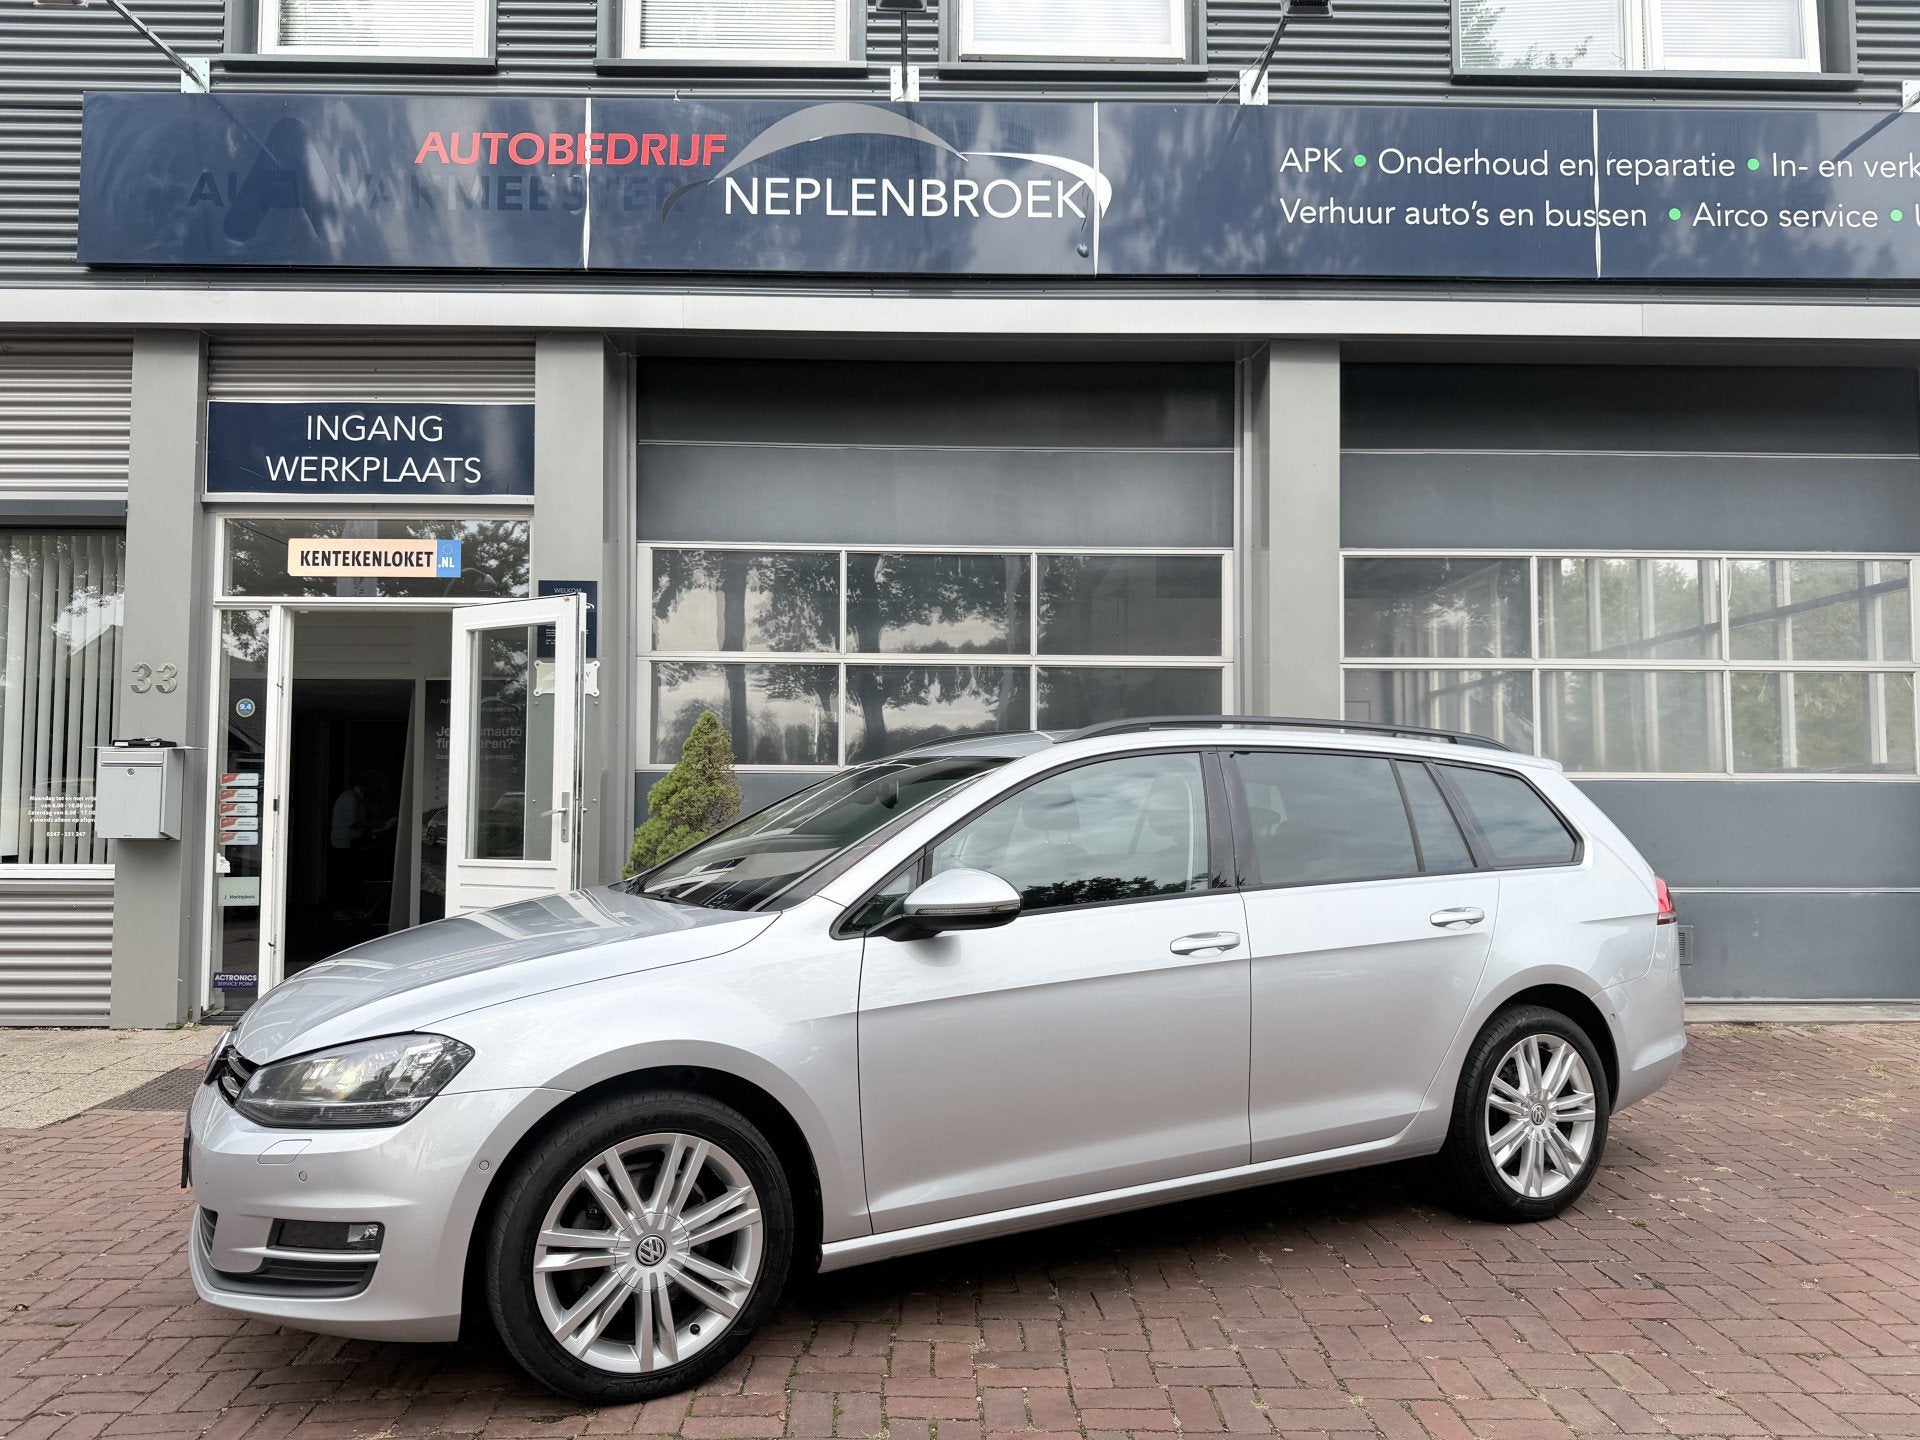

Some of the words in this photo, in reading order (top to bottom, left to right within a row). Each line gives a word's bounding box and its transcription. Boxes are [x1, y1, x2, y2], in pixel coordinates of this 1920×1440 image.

[414, 131, 727, 166] AUTOBEDRIJF
[1280, 147, 1343, 173] APK
[1378, 148, 1549, 176] Onderhoud
[1559, 157, 1594, 177] en
[1606, 152, 1736, 186] reparatie
[1773, 152, 1808, 178] In-
[1818, 158, 1853, 178] en
[725, 176, 1088, 220] NEPLENBROEK
[1280, 197, 1396, 225] Verhuur
[1405, 200, 1489, 226] auto's
[1499, 207, 1534, 226] en
[1546, 200, 1647, 228] bussen
[1692, 202, 1768, 228] Airco
[1778, 203, 1878, 228] service
[307, 414, 443, 443] INGANG
[265, 456, 482, 484] WERKPLAATS
[300, 550, 434, 568] KENTEKENLOKET
[130, 662, 178, 694] 33
